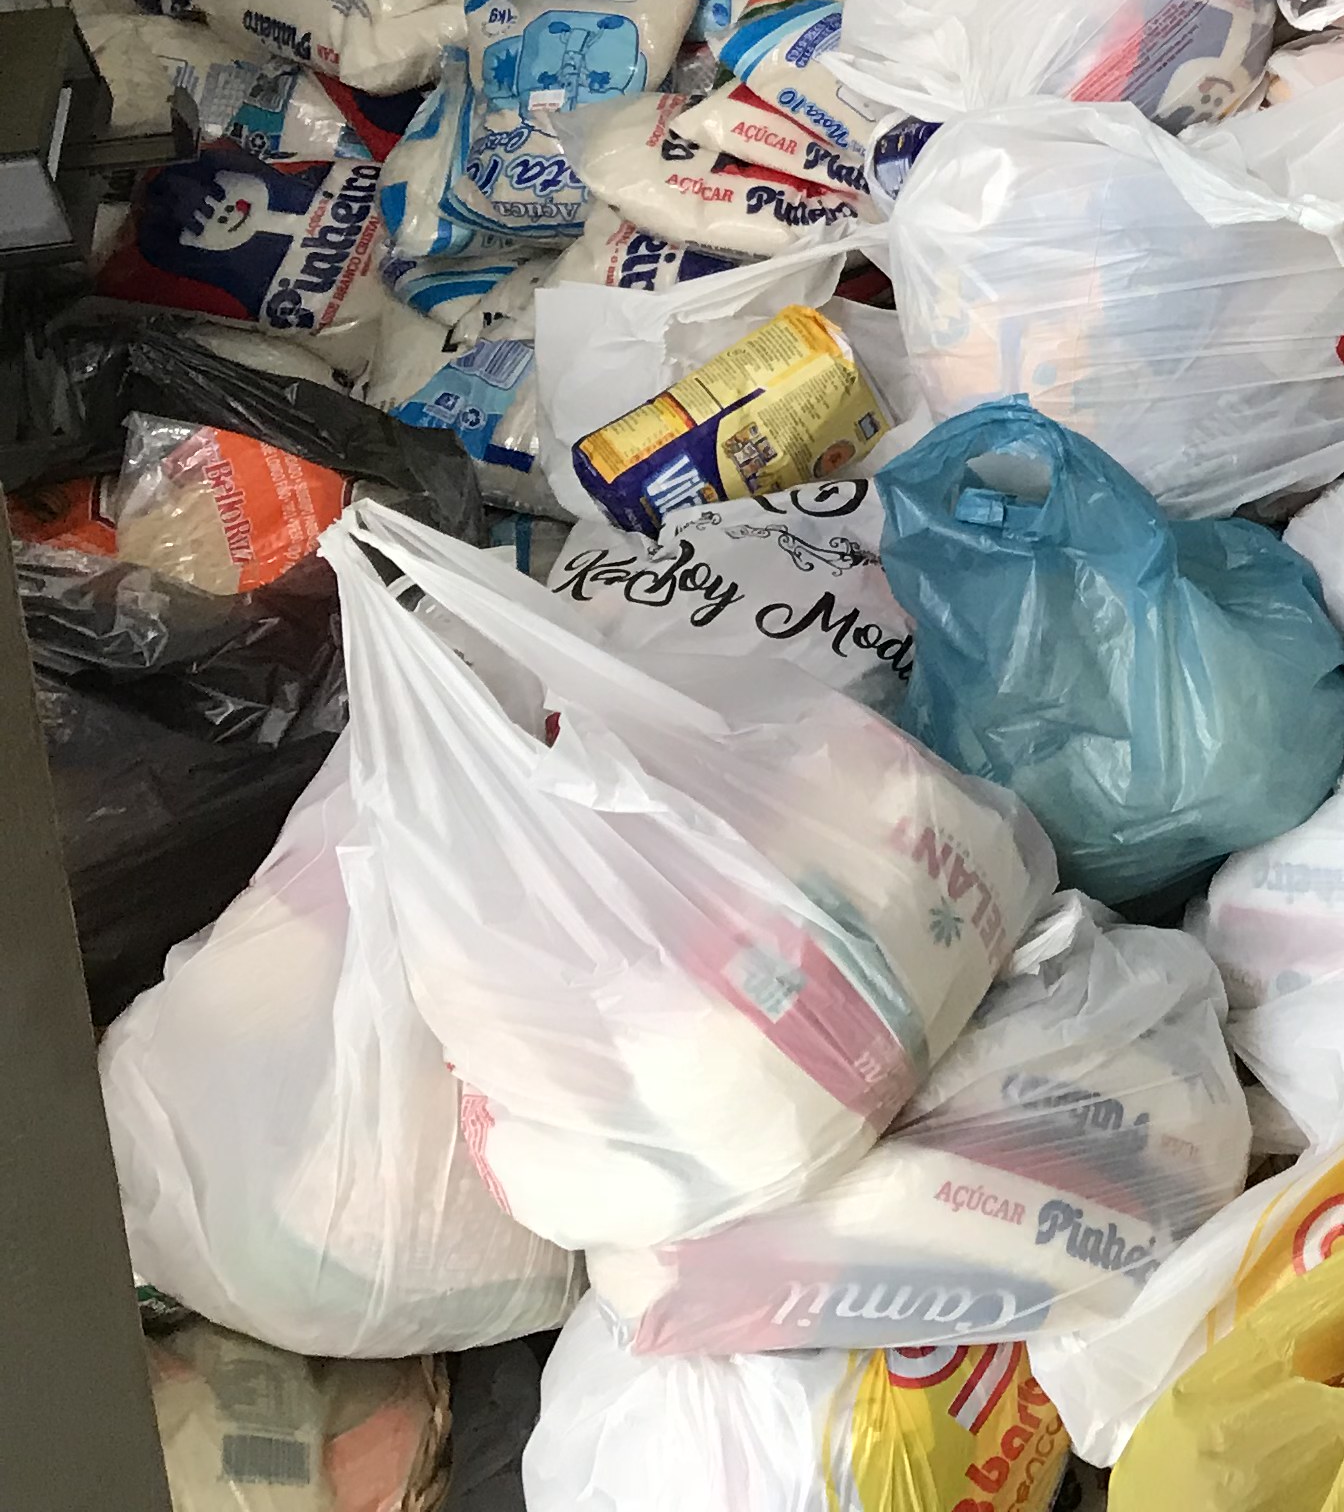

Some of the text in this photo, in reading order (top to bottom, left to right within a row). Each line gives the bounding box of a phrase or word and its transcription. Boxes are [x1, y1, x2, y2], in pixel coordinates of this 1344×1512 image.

[730, 121, 798, 155] AÇÚCAR
[778, 87, 851, 149] Nota 10
[498, 198, 581, 222] Açúca
[663, 171, 736, 205] AÇÚCAR
[261, 165, 382, 335] Pinheiro
[933, 1180, 1027, 1228] AÇÚCAR
[771, 1281, 1019, 1331] Camil
